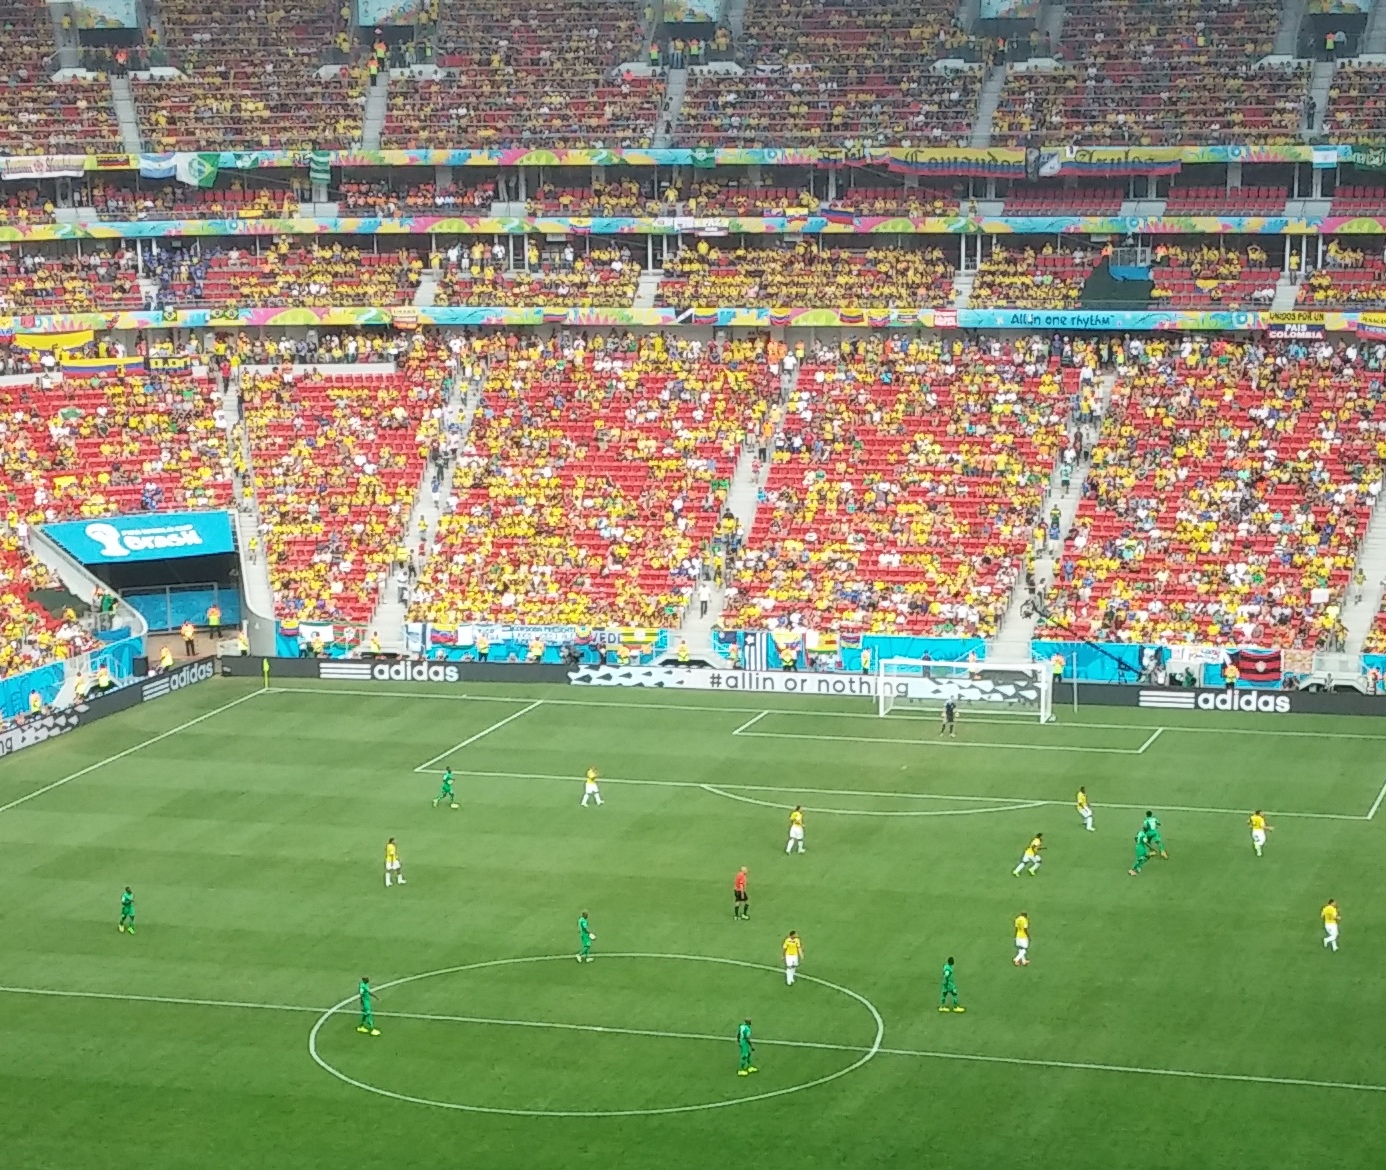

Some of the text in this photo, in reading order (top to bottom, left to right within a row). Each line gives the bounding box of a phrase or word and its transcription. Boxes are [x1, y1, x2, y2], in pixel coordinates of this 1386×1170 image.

[1045, 316, 1067, 325] one
[1269, 331, 1323, 339] COLOMBIA
[169, 661, 214, 691] adidas
[373, 660, 460, 683] adidas
[709, 672, 909, 697] #allin or nothing
[1197, 689, 1291, 713] adidas
